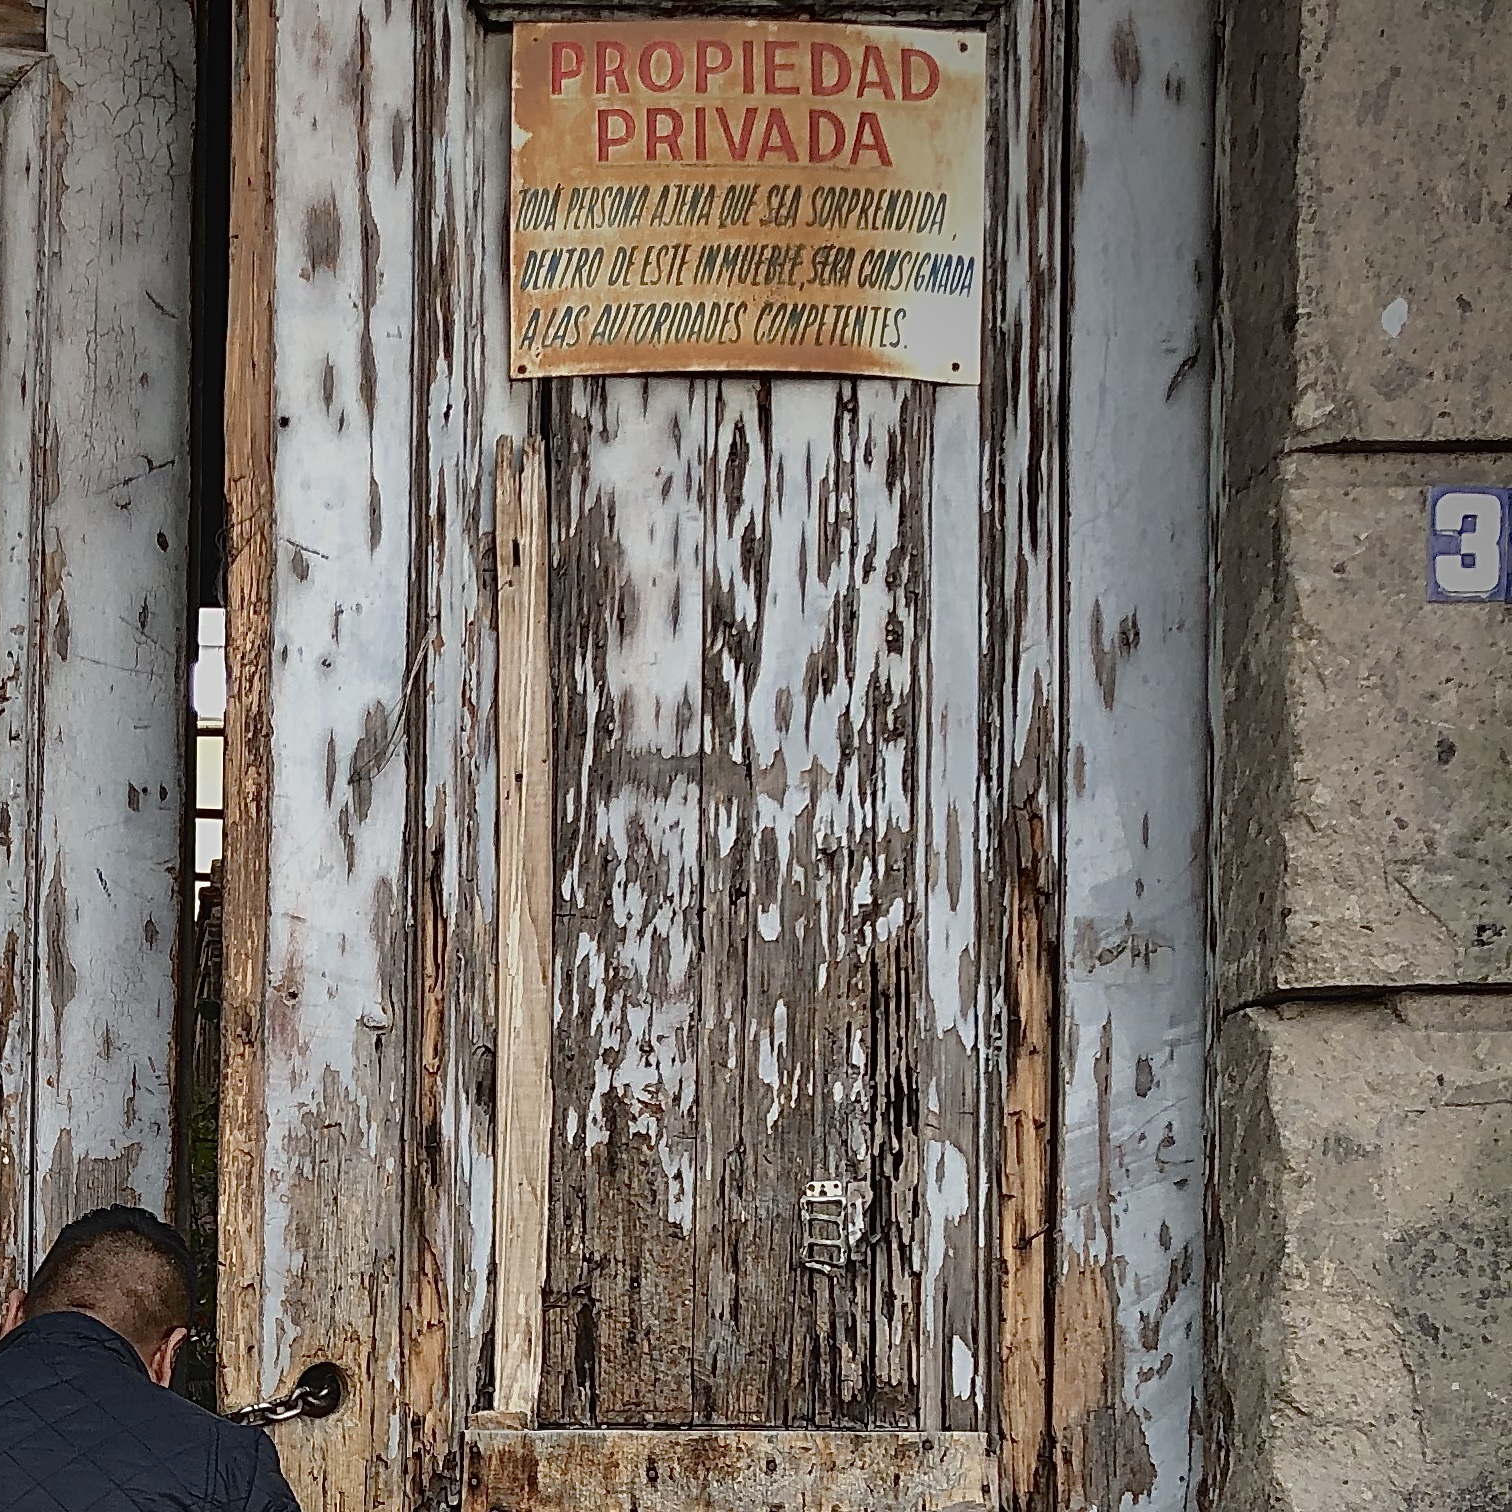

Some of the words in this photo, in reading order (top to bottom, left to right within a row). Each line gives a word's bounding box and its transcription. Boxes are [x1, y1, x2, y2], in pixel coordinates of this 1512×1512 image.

[550, 40, 940, 101] PROPIEDAD
[597, 106, 893, 167] PRIVADA
[515, 183, 564, 231] TODA
[564, 184, 650, 230] PERSONA
[650, 183, 716, 227] AJENA
[718, 183, 760, 229] QUE
[759, 184, 802, 229] SEA
[805, 186, 947, 235] SORPRENDIDA
[520, 247, 605, 290] DENTRO
[608, 245, 638, 286] DE
[639, 243, 691, 286] ESTE
[857, 249, 975, 298] CONSIGNADA
[519, 308, 541, 351] A
[589, 301, 748, 346] AUTORIDADES
[753, 302, 908, 349] COMPETENTES.
[1435, 492, 1502, 598] 3
